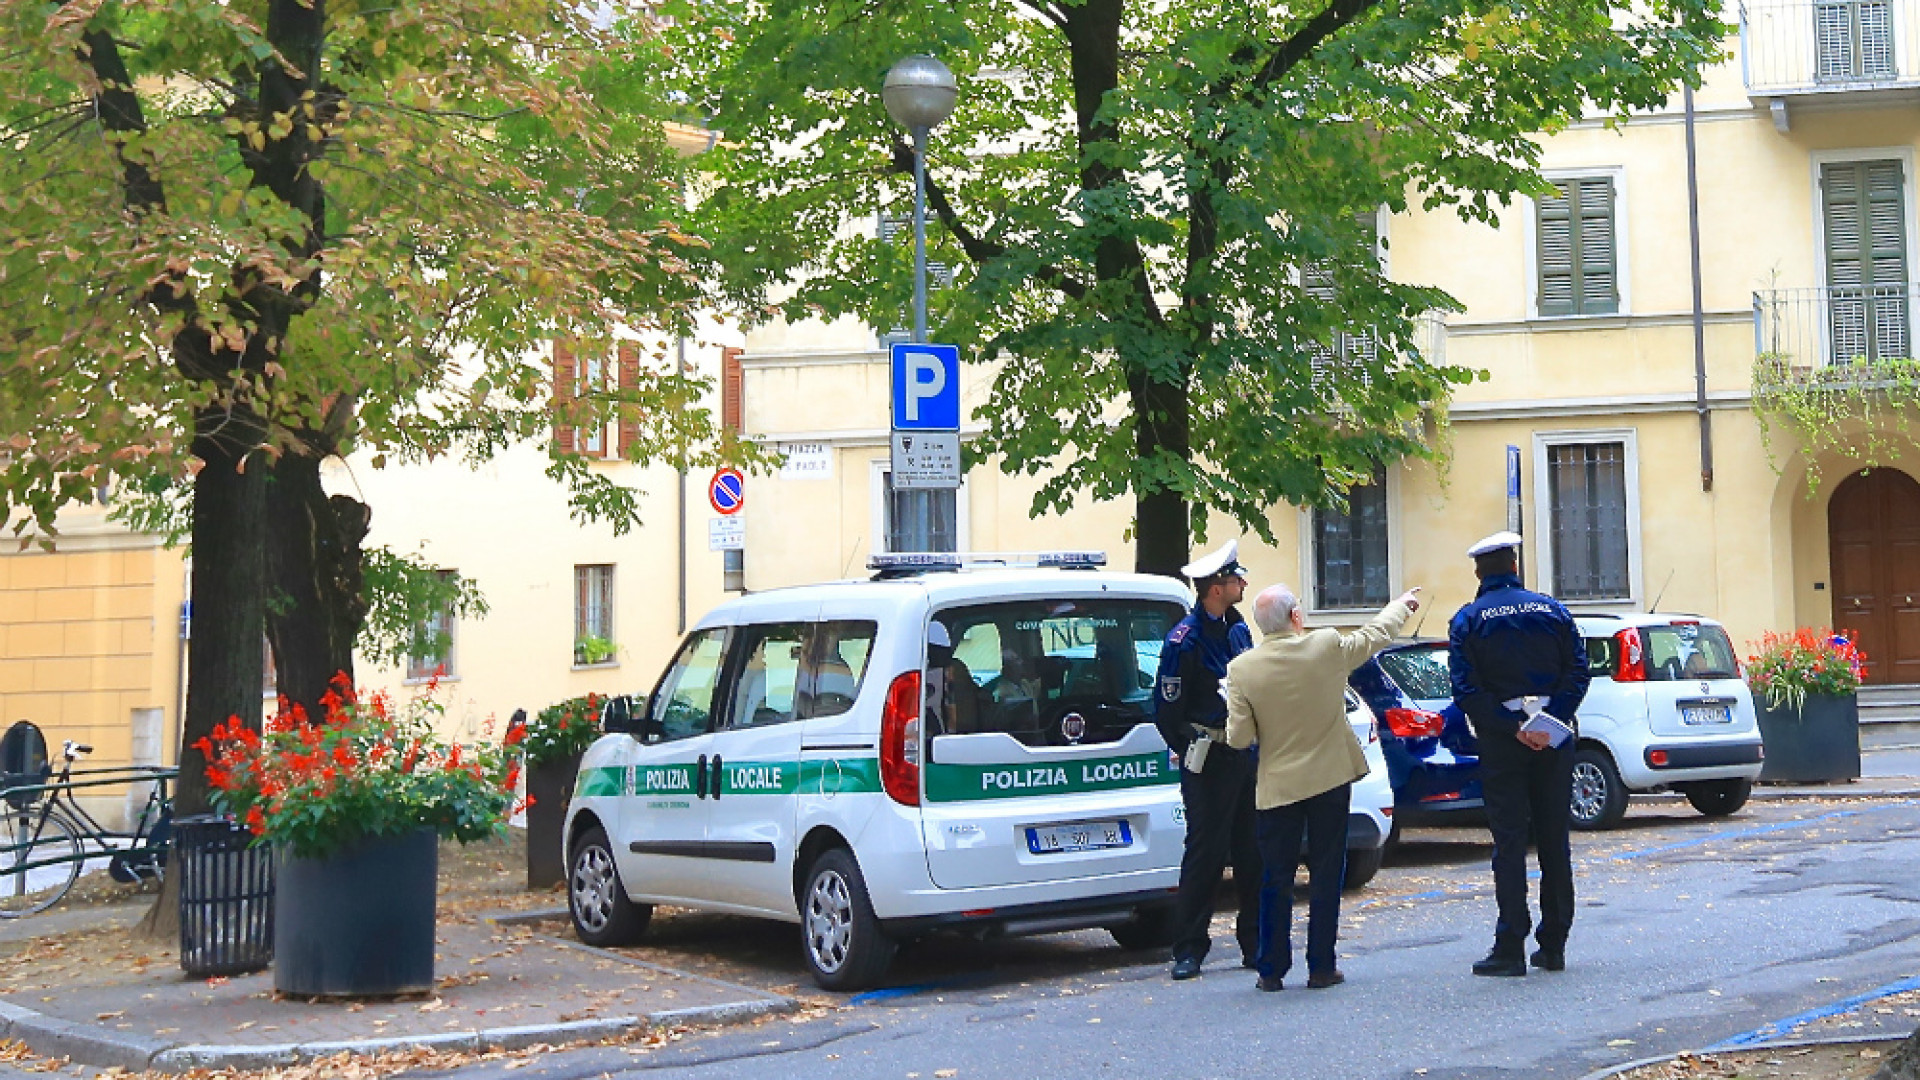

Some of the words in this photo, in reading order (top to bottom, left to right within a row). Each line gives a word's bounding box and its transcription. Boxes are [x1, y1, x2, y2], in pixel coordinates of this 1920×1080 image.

[905, 353, 946, 421] P
[1481, 605, 1517, 620] POLIZIA
[1518, 601, 1552, 613] LOCALE
[646, 769, 690, 790] POLIZIA
[730, 767, 782, 789] LOCALE
[982, 767, 1069, 791] POLIZIA
[1082, 760, 1159, 783] LOCALE
